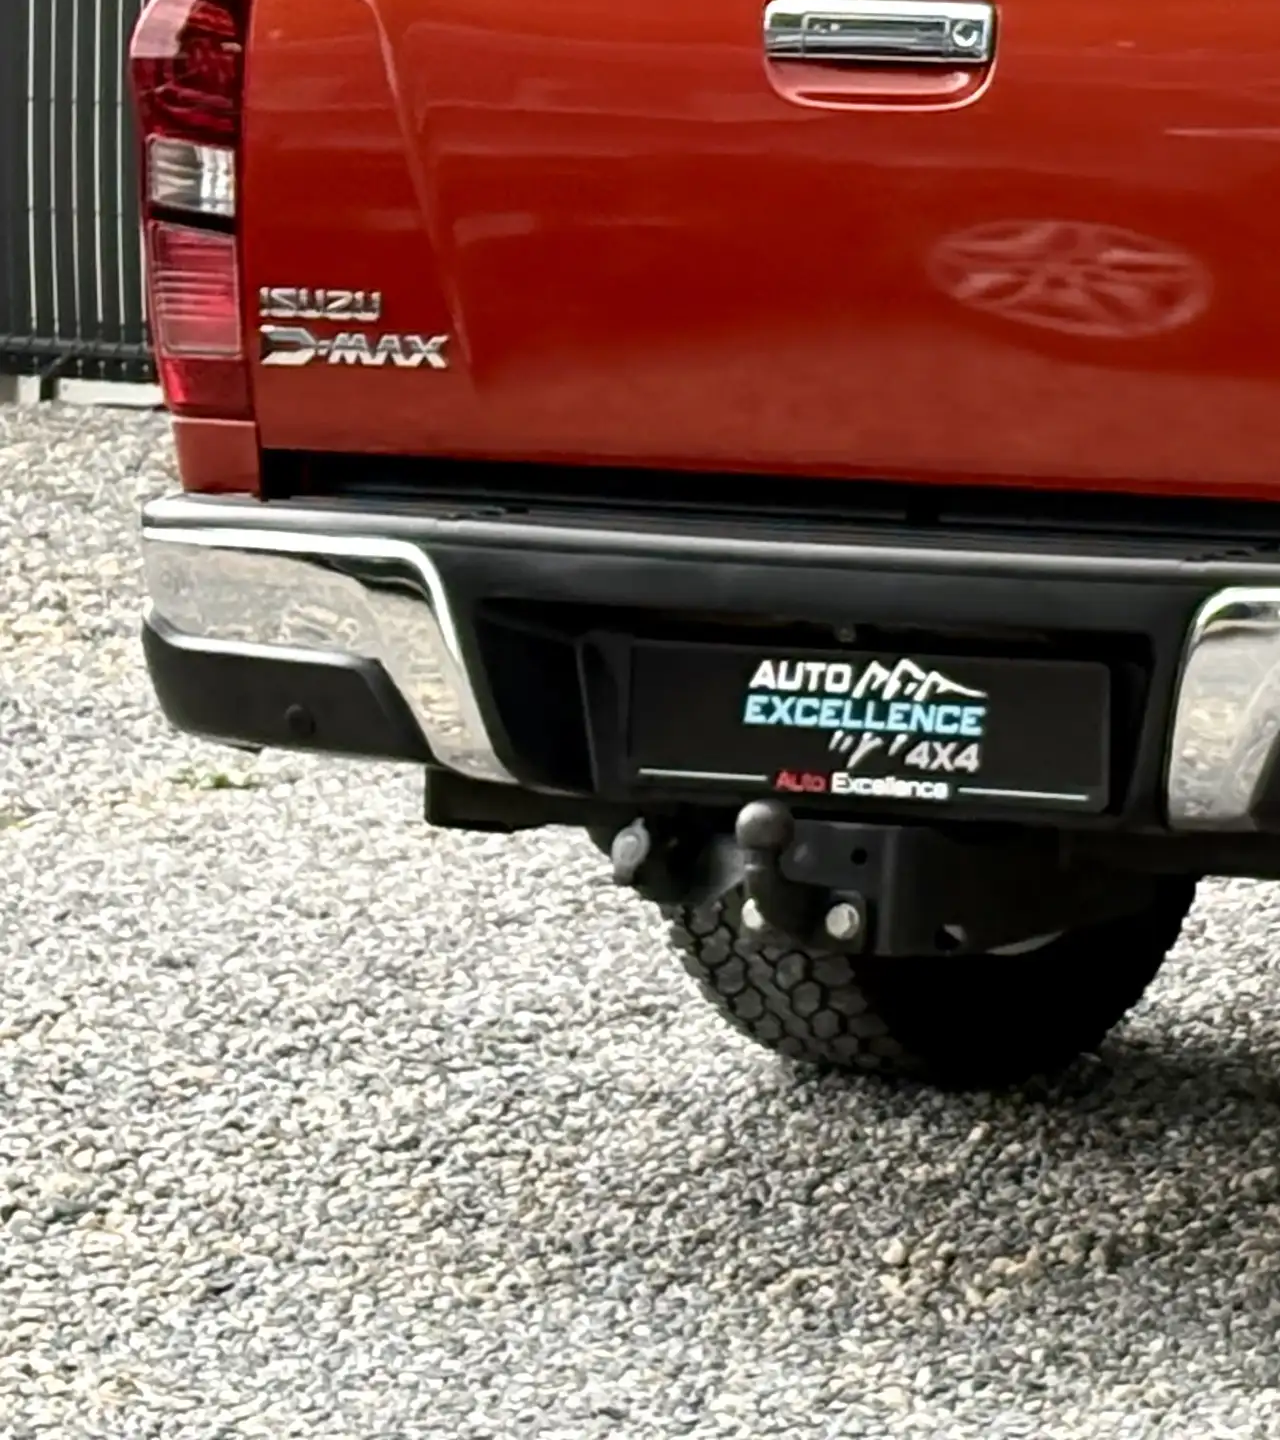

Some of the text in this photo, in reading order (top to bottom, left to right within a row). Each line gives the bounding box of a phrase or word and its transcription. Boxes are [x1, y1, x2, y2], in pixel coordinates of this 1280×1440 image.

[259, 286, 382, 321] ISUZU
[259, 323, 448, 368] D-MAX
[748, 660, 851, 692] AUTO
[743, 694, 987, 737] EXCELLENCE
[831, 773, 950, 800] Excellence
